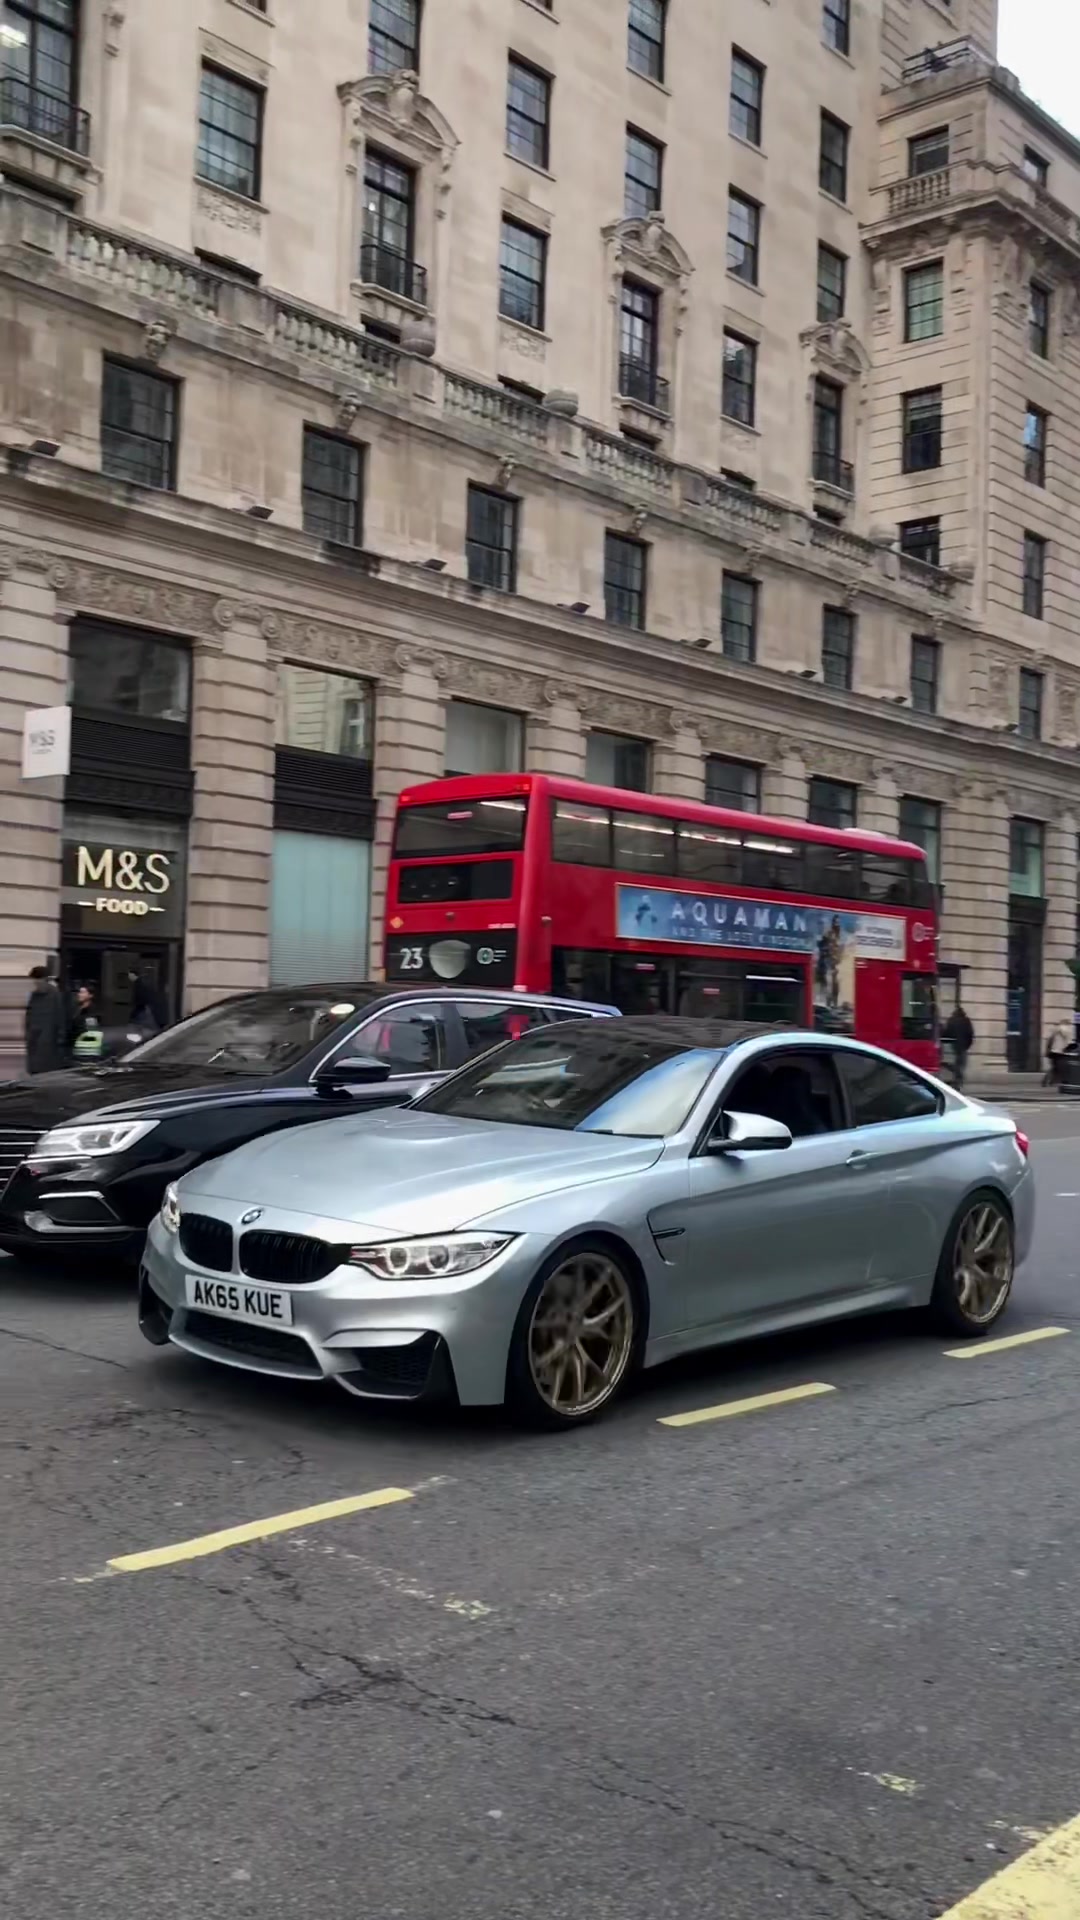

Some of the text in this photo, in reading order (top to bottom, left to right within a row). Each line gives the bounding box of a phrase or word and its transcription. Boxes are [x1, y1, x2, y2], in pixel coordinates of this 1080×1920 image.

[78, 845, 170, 894] M&S
[95, 897, 149, 915] FOOD
[671, 901, 807, 932] AQUAMAN
[400, 947, 424, 970] 23
[194, 1280, 283, 1319] AK65 KUE
